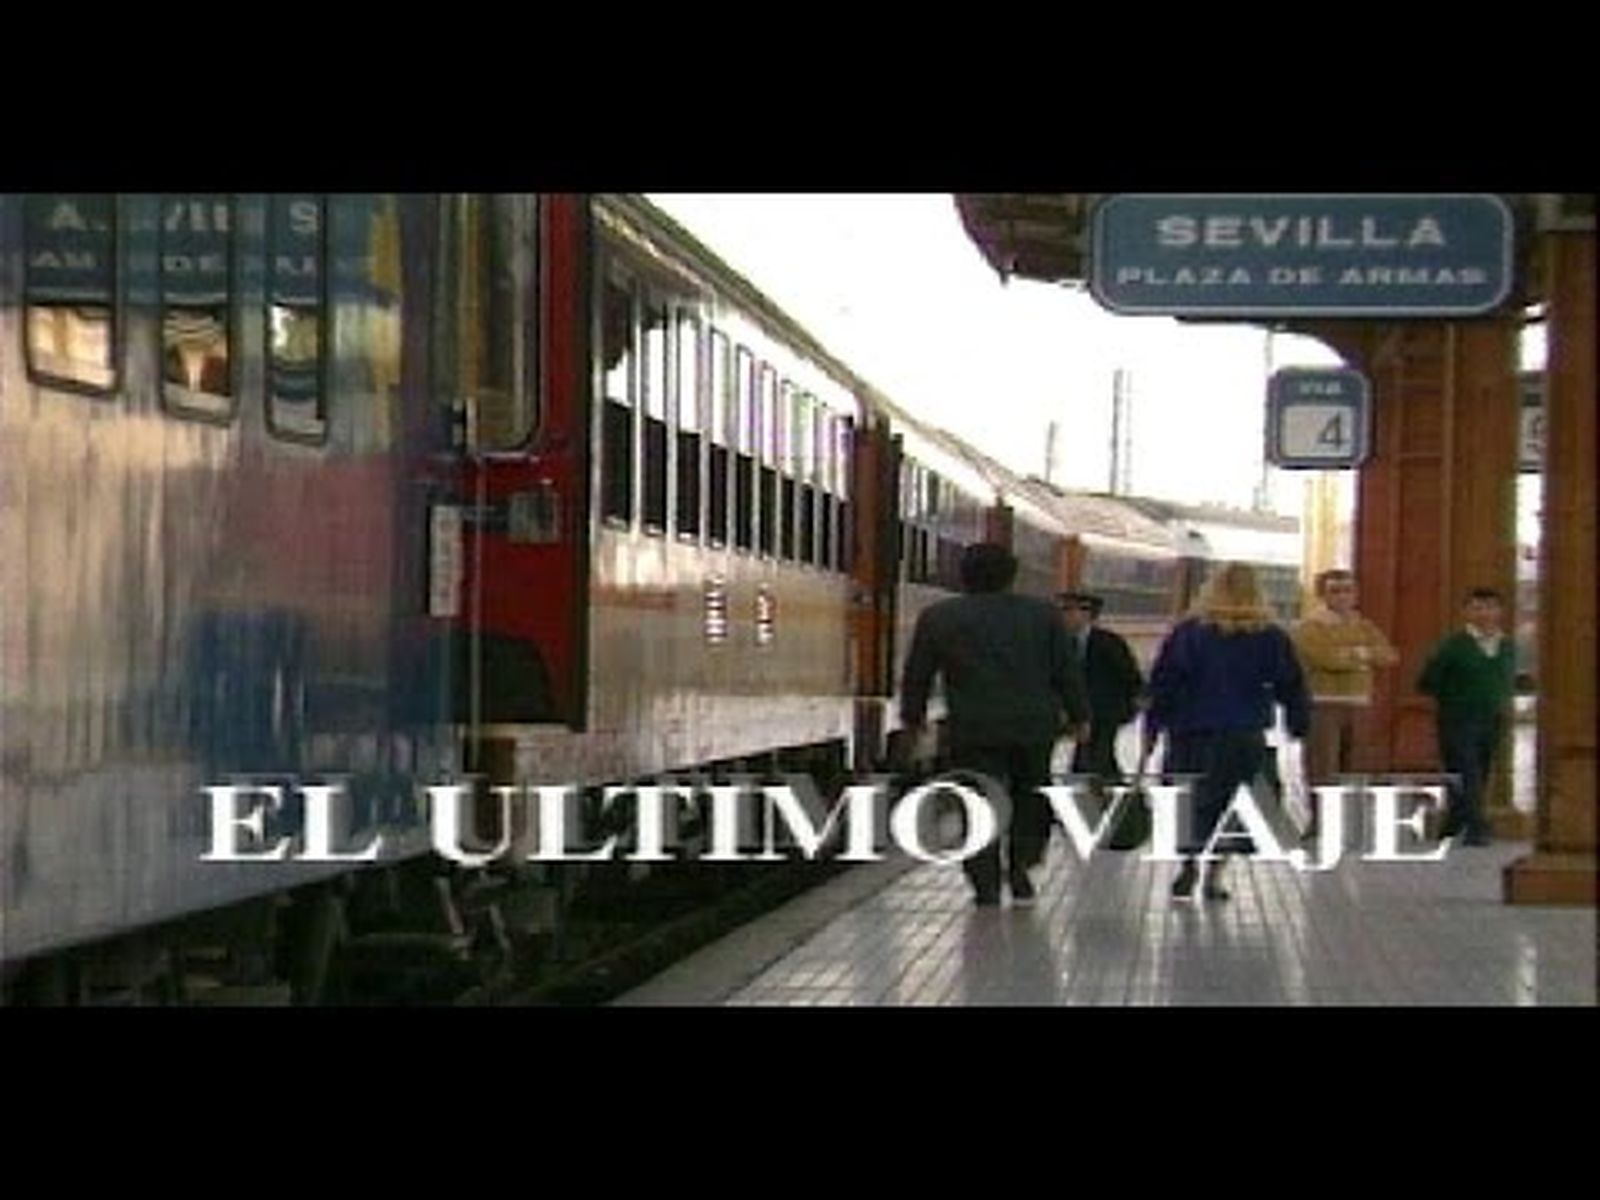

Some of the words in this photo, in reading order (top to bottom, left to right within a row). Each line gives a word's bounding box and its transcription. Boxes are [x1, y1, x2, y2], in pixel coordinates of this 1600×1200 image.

[1154, 214, 1446, 248] SEVILLA
[1115, 265, 1252, 285] PLAZA
[1267, 265, 1322, 285] DE
[1338, 265, 1488, 286] ARMAS
[1316, 410, 1347, 450] 4
